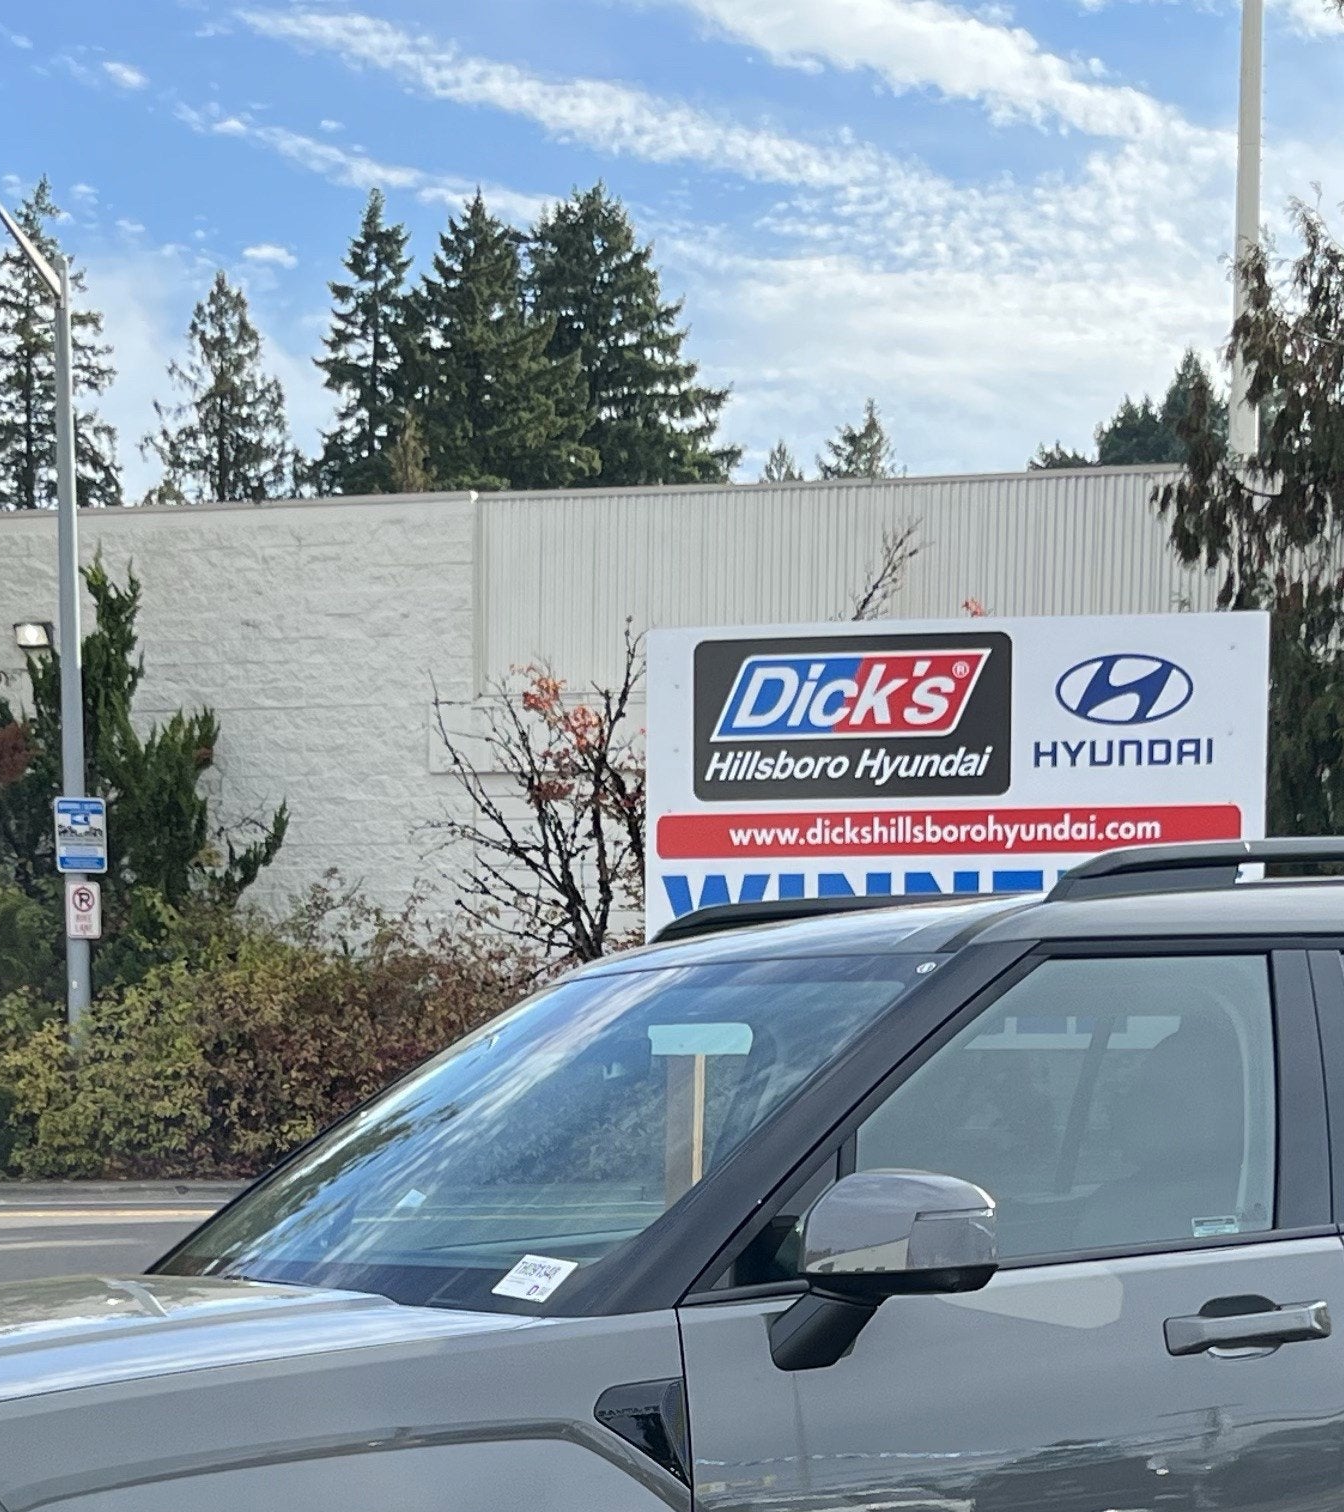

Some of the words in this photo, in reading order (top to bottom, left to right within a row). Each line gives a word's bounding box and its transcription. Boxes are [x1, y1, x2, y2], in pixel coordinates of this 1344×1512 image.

[705, 750, 849, 781] Hillsboro
[855, 746, 993, 786] Hyundai
[1033, 737, 1214, 768] HYUNDAI
[729, 814, 1162, 849] www.dickshillsborohyundai.com
